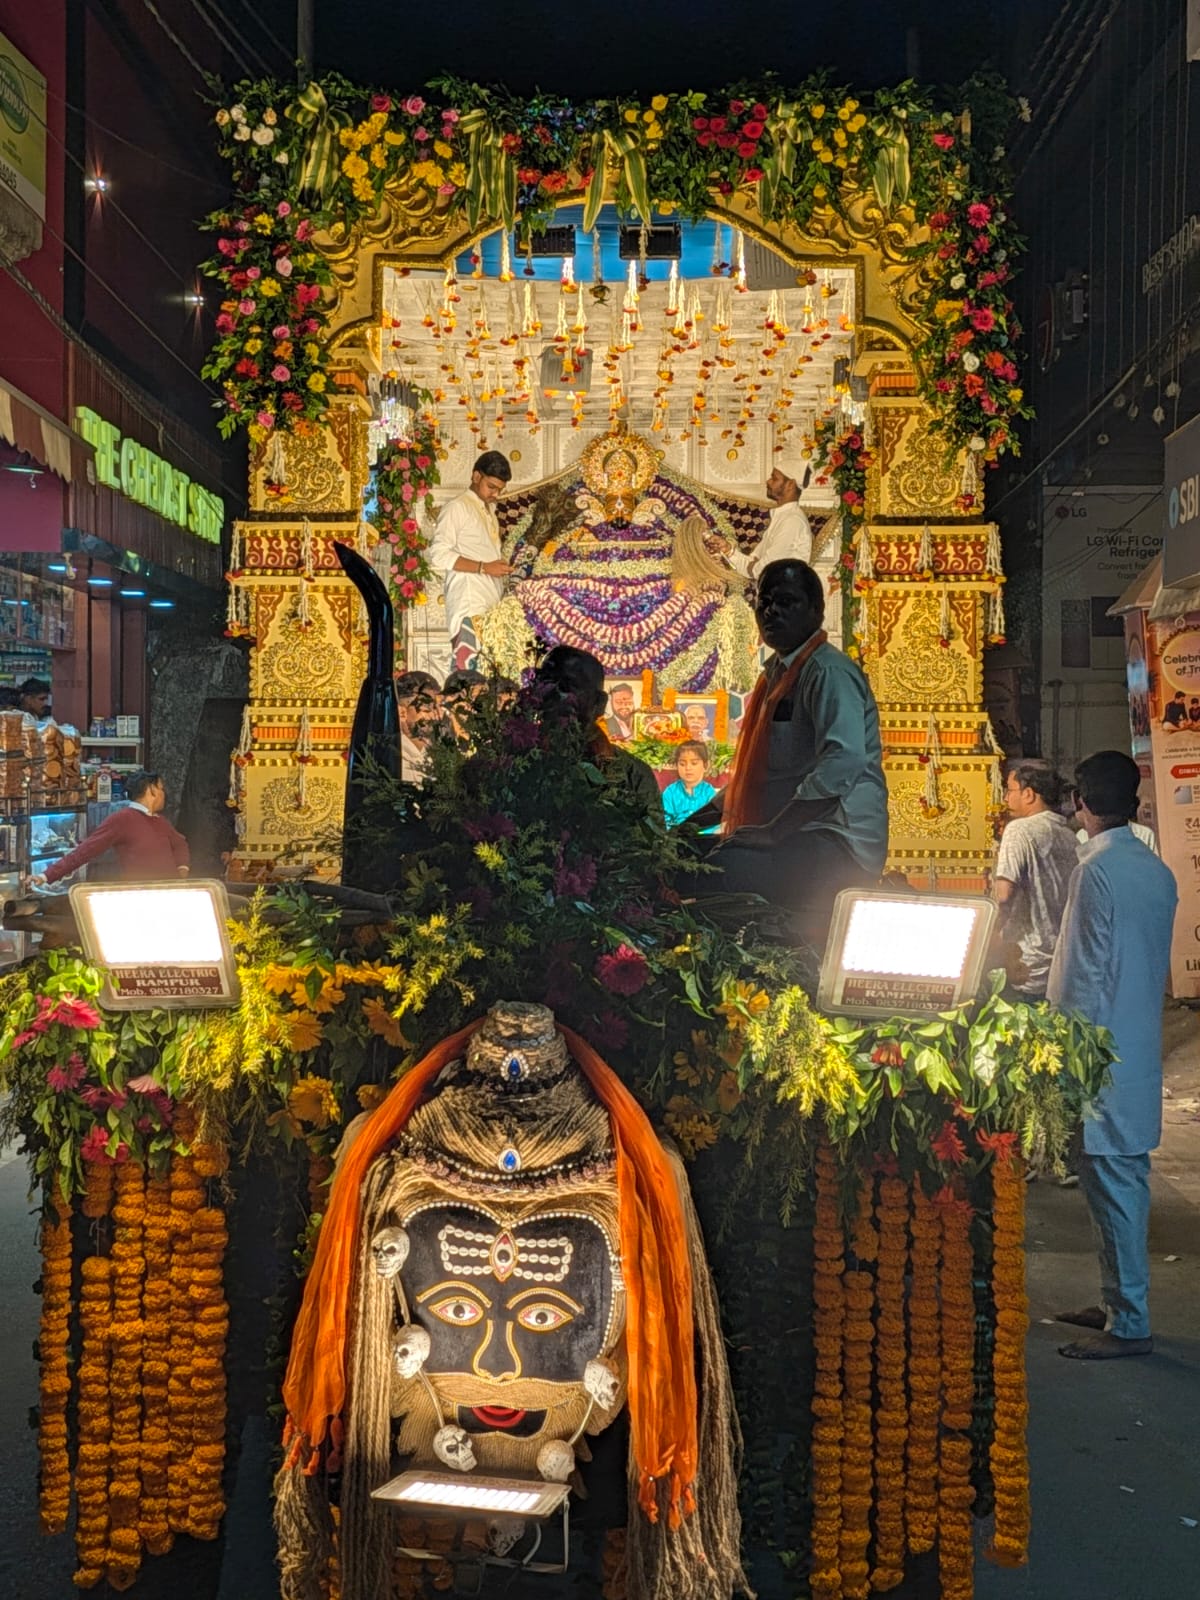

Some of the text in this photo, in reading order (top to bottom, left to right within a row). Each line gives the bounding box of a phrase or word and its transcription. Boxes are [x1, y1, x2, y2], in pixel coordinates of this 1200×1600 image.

[75, 405, 121, 489] THE
[1180, 473, 1199, 524] SBI
[1071, 507, 1088, 518] LG
[1087, 535, 1103, 546] LG
[1105, 535, 1139, 546] Wi-Fi
[1175, 665, 1186, 676] of
[159, 967, 218, 978] ELECTRIC
[135, 978, 201, 987] RAMPUR
[120, 987, 147, 996] Mob.
[892, 983, 954, 995] ELECTRIC
[865, 989, 931, 1001] RAMPUR
